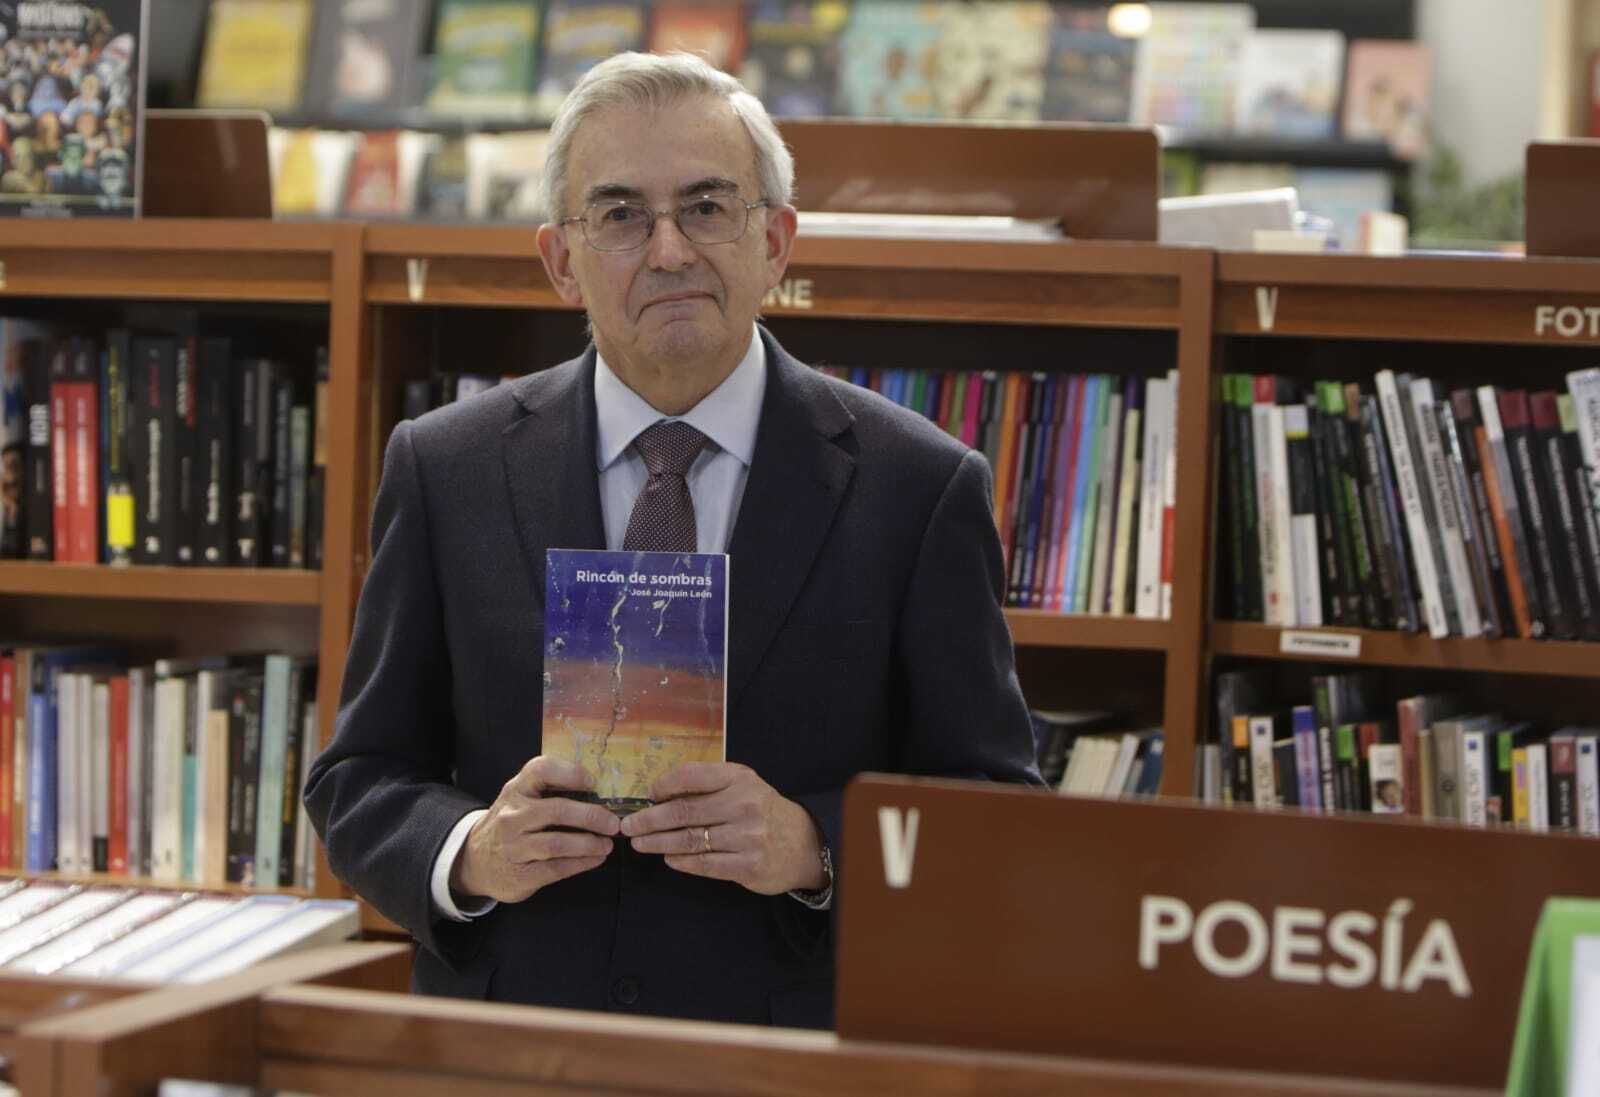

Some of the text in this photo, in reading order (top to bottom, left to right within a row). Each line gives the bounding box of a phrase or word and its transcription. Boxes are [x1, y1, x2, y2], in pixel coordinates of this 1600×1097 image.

[761, 279, 815, 309] NE
[1535, 305, 1600, 337] FOT
[576, 569, 712, 586] Rincón de sombras
[631, 588, 712, 600] José Joaquín León
[878, 806, 921, 888] V
[1138, 895, 1472, 997] POESÍA
